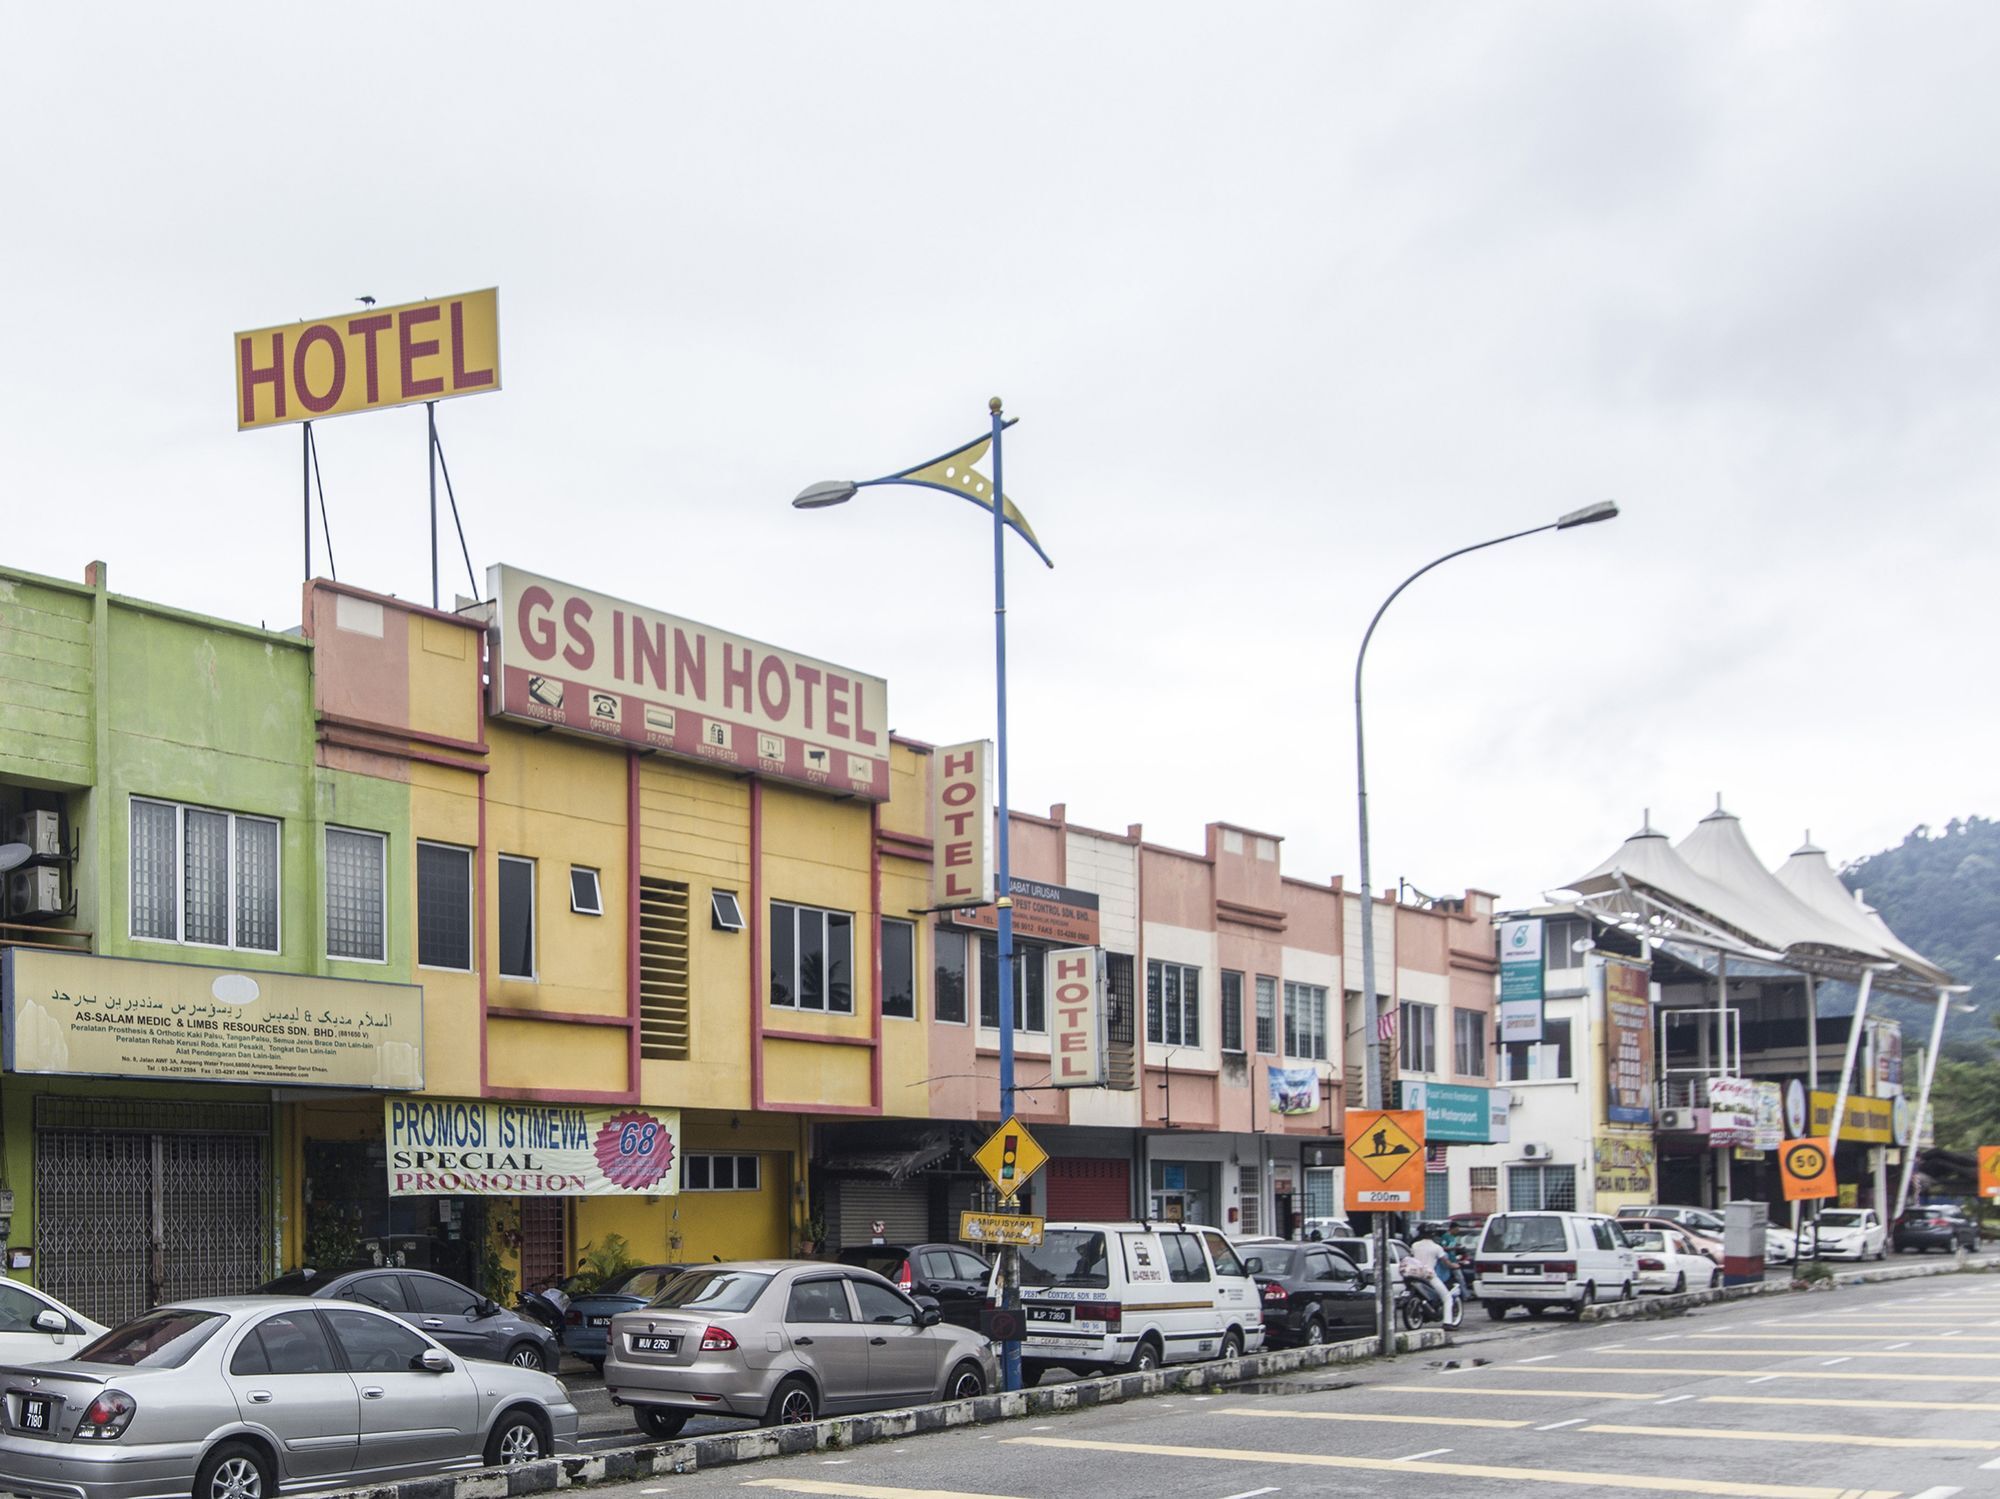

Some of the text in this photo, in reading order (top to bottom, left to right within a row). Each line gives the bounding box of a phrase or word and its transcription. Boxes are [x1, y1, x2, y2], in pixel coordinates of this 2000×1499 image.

[241, 300, 493, 423] HOTEL
[518, 585, 877, 747] GS INN HOTEL
[590, 718, 621, 735] OPERATOR
[767, 741, 776, 751] TV
[774, 762, 785, 774] TV
[807, 770, 827, 784] CCTV
[942, 750, 976, 896] HOTEL
[1031, 884, 1060, 900] URUSAN
[1016, 899, 1031, 911] PEST
[1033, 902, 1060, 916] CONTROL
[76, 1011, 134, 1024] AS-SALAM
[137, 1015, 171, 1026] MEDIC
[176, 1018, 184, 1027] &
[187, 1019, 218, 1030] LIMBS
[223, 1022, 285, 1035] RESOURCES
[287, 1026, 310, 1036] SDN.
[1056, 958, 1089, 1077] HOTEL
[71, 1024, 107, 1032] Peralatan
[108, 1026, 147, 1035] Prosthesis
[157, 1029, 185, 1038] Orthotic
[204, 1032, 225, 1041] Palsu,
[227, 1034, 250, 1043] Tangan
[273, 1037, 295, 1045] Semua
[315, 1039, 333, 1047] Brace
[348, 1041, 374, 1049] Lain-lain
[116, 1035, 151, 1044] Peralatan
[152, 1036, 175, 1045] Rehab
[176, 1038, 200, 1047] Kerusi
[269, 1044, 295, 1054] Tongkat
[310, 1047, 337, 1055] Lain-lain
[176, 1047, 190, 1055] Alat
[192, 1049, 237, 1058] Pendengaran
[180, 1059, 203, 1067] Ampang
[392, 1102, 589, 1150] PROMOSI ISTIMEWA
[619, 1121, 658, 1156] 68
[394, 1151, 543, 1170] SPECIAL
[1796, 1154, 1818, 1168] 50
[394, 1172, 586, 1191] PROMOTION
[1370, 1192, 1400, 1202] 200m
[1002, 1220, 1035, 1228] ISYARAT
[1048, 1291, 1075, 1299] CONTROL
[653, 1339, 670, 1350] 2750
[26, 1413, 43, 1428] 7180
